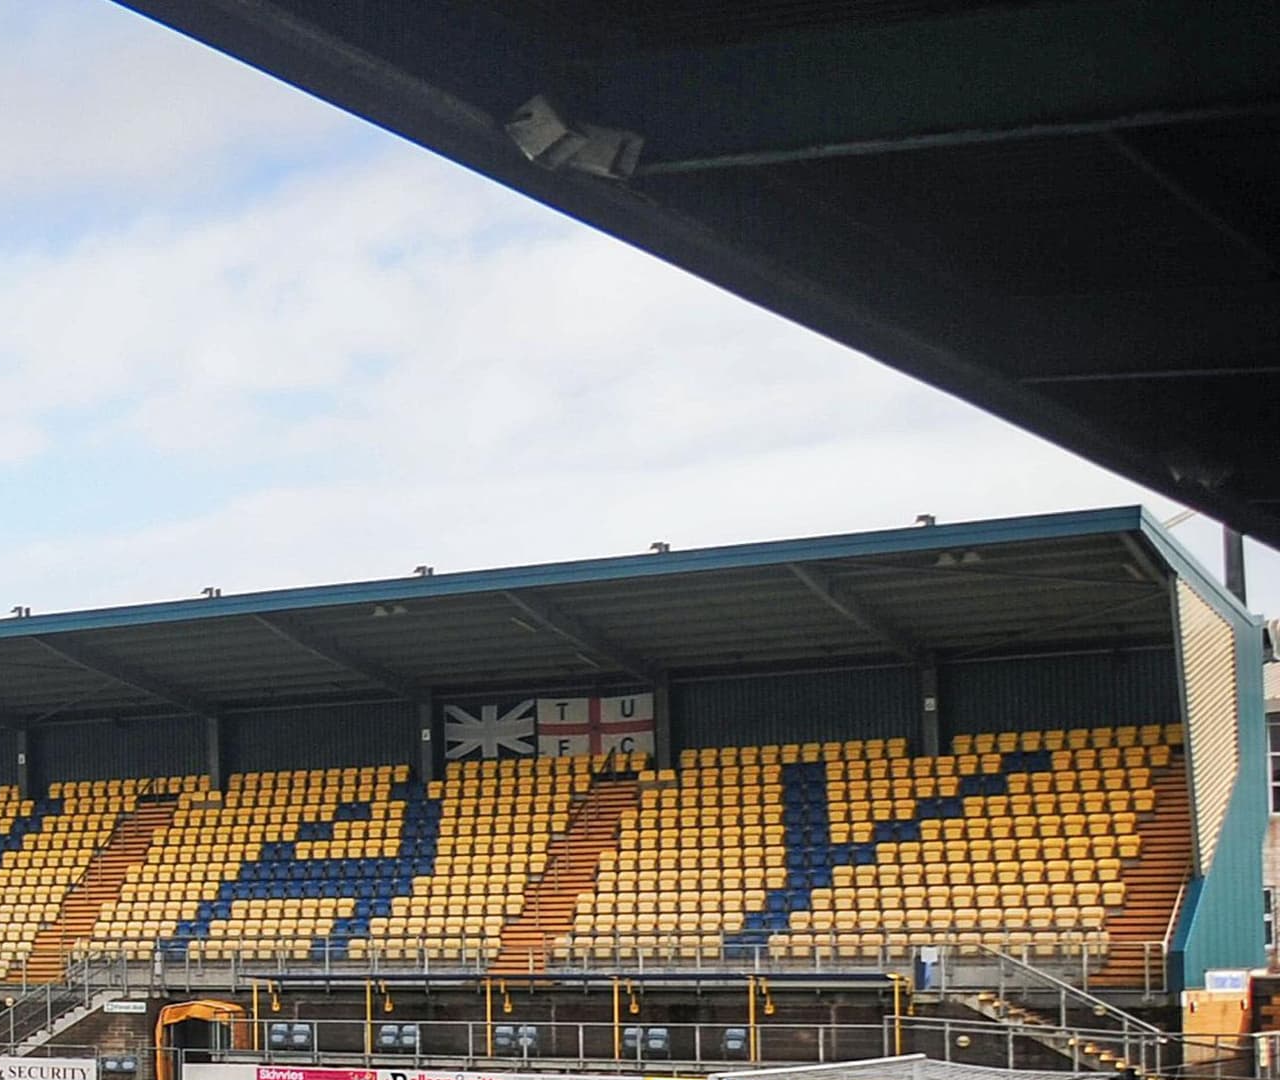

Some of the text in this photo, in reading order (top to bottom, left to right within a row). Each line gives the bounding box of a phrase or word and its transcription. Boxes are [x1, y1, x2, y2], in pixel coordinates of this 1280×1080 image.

[555, 698, 635, 721] T U
[558, 737, 635, 756] F C
[8, 1065, 90, 1080] SECURITY
